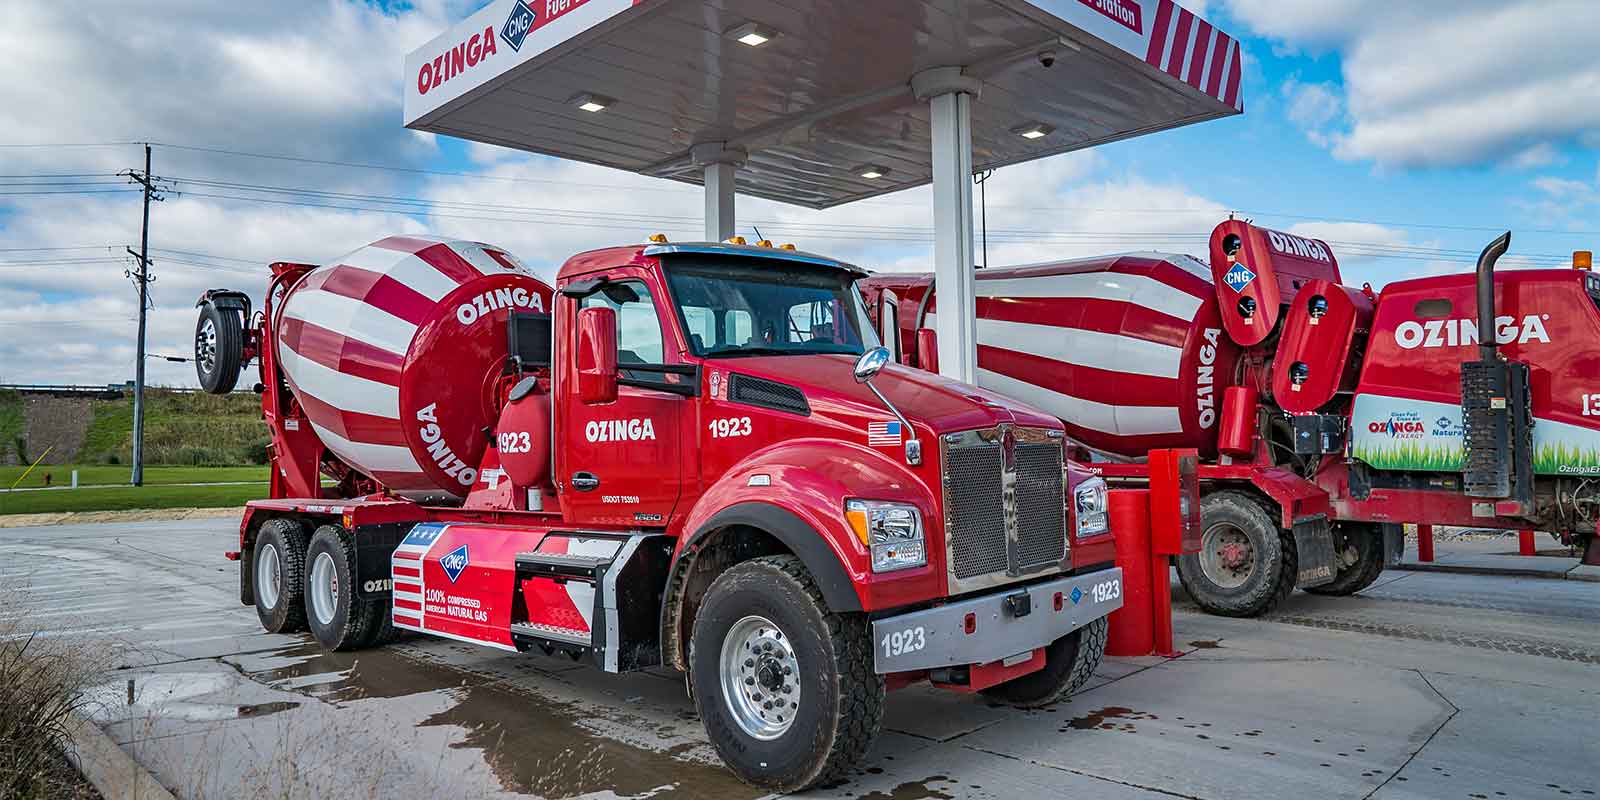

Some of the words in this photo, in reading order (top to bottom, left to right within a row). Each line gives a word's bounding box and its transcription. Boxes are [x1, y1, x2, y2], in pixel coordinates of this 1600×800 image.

[508, 16, 528, 38] CNG
[417, 25, 497, 95] OZINGA
[1269, 231, 1330, 262] OZINGA
[1227, 270, 1249, 284] CNG
[456, 287, 544, 326] OZINGA
[1197, 327, 1221, 430] OZINGA
[585, 418, 656, 442] OZINGA
[708, 416, 752, 438] 1923
[1433, 429, 1463, 437] Natura
[416, 402, 478, 486] OZINGA
[497, 431, 531, 454] 1923
[445, 555, 464, 570] CNG
[426, 588, 446, 604] 100%
[447, 595, 481, 609] COMPRESSED
[1091, 579, 1120, 603] 1923
[447, 605, 474, 620] NATURAL
[474, 609, 488, 622] GAS
[881, 627, 926, 658] 1923
